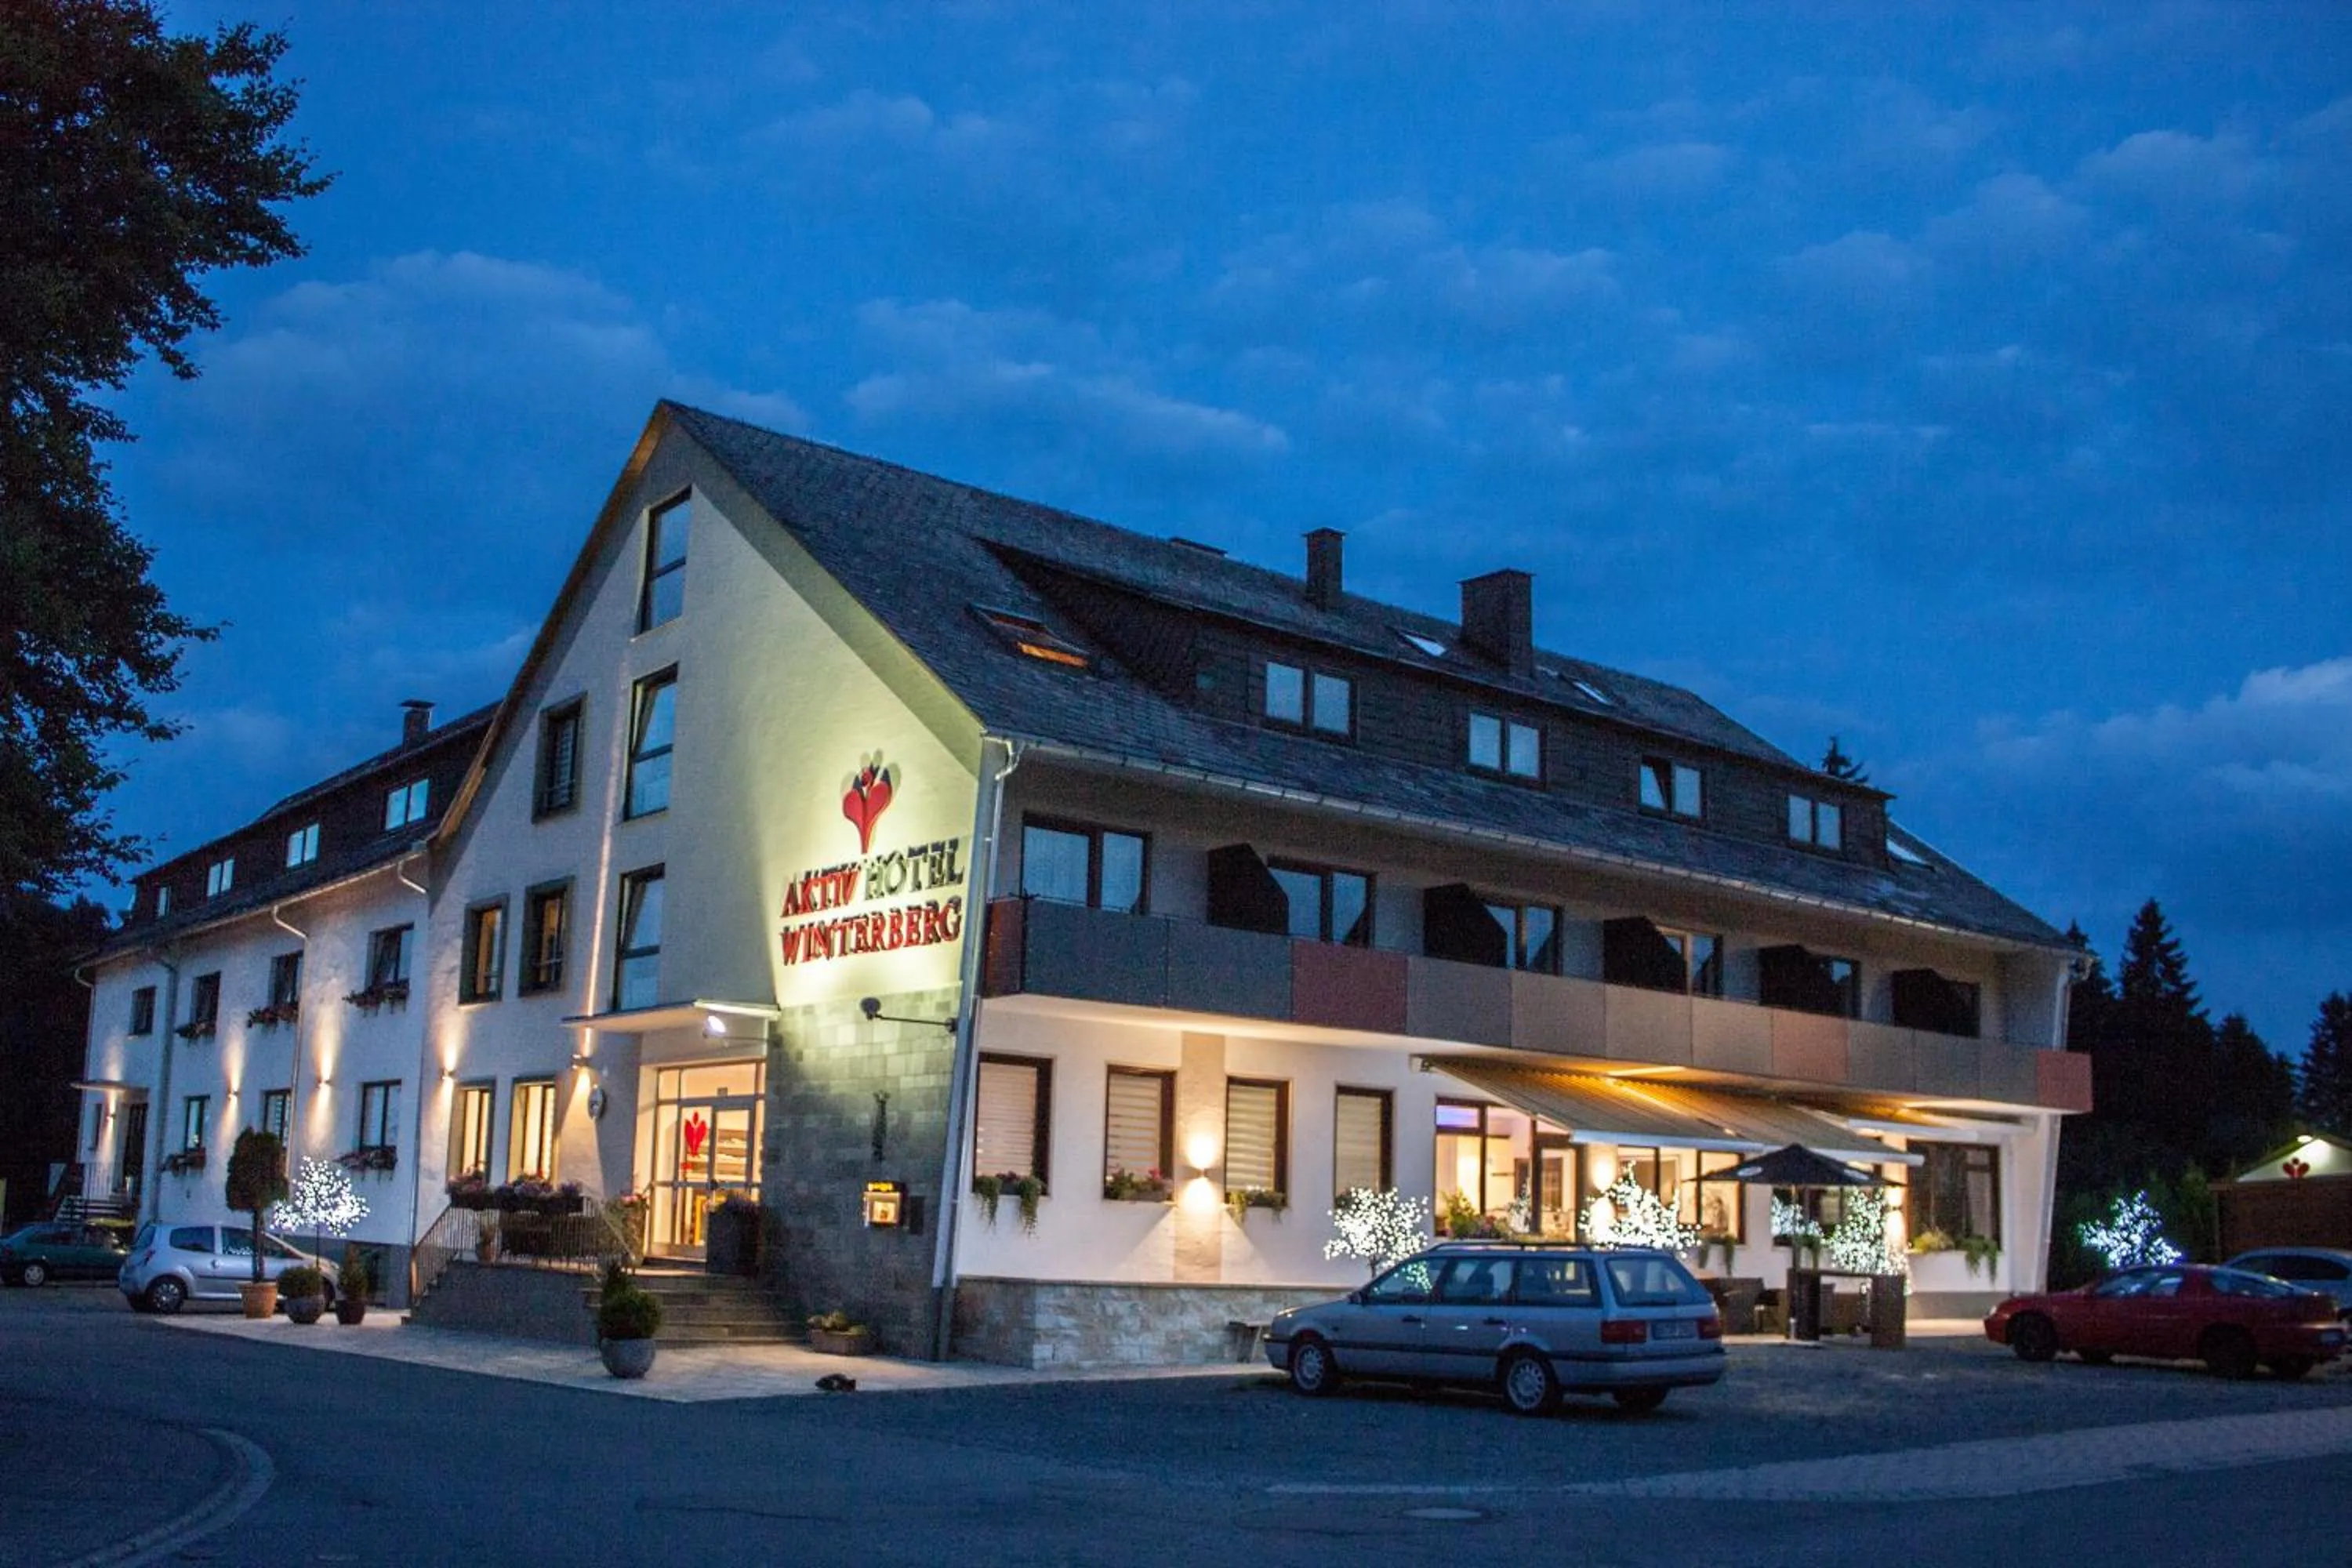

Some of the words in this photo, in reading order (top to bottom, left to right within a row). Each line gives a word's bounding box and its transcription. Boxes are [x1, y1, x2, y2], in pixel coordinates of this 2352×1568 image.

[781, 867, 859, 917] AKTIV
[864, 839, 964, 900] HOTEL
[779, 898, 962, 965] WINTERBERG
